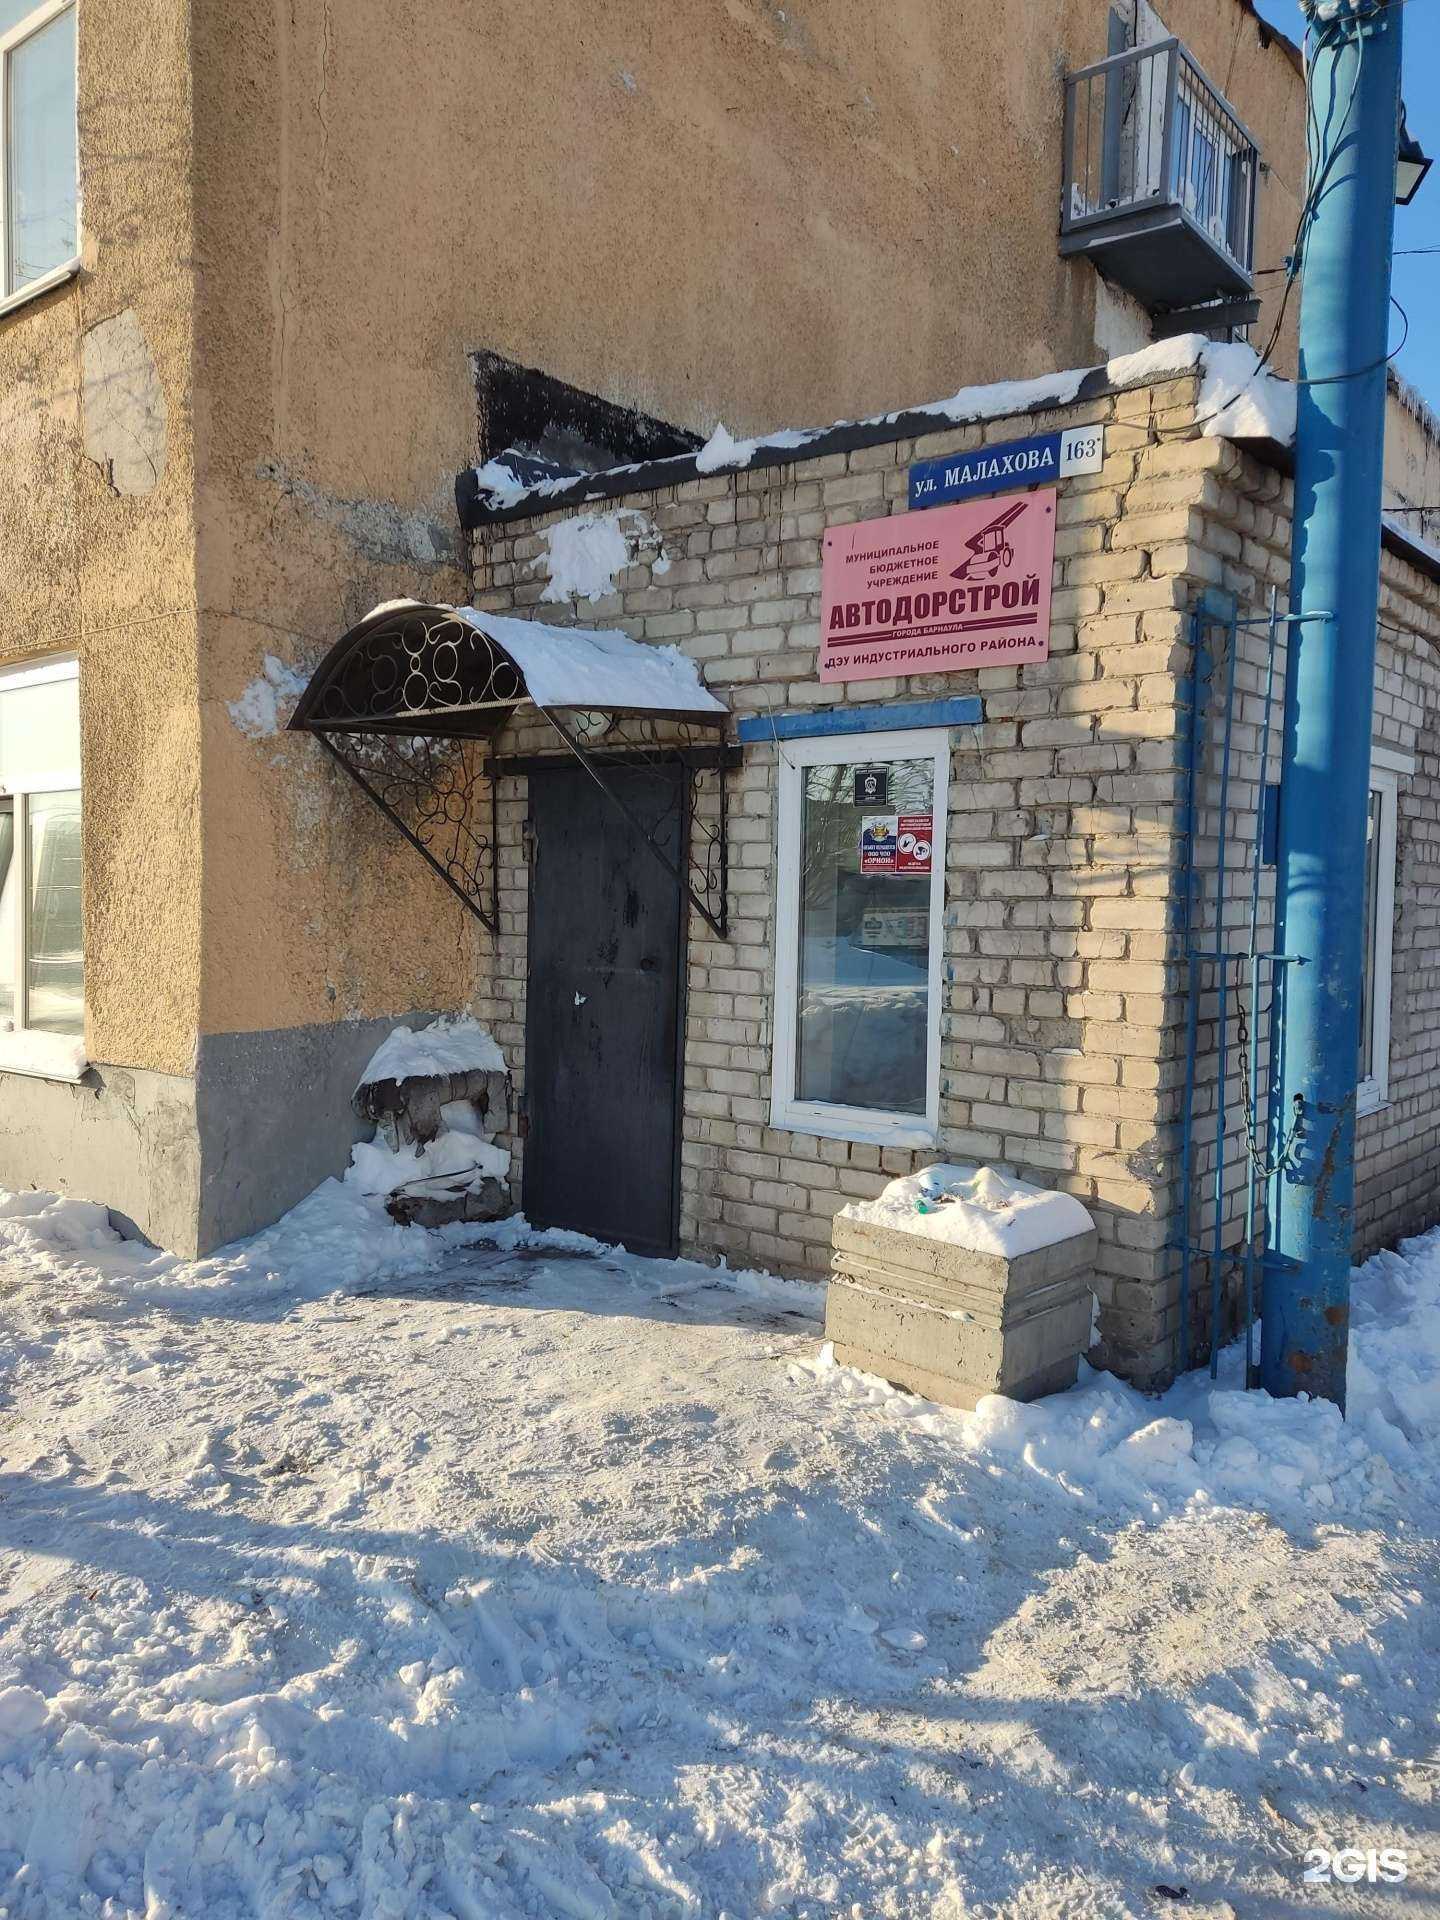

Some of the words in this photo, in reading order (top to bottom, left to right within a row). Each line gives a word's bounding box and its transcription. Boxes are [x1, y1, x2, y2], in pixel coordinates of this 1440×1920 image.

[915, 478, 937, 498] ул.
[944, 447, 1055, 488] МАЛАХОВА
[1066, 438, 1096, 462] 163
[845, 540, 940, 564] МУНИЦИПАЛЬНОЕ
[869, 555, 939, 575] БЮДЖЕТНОЕ
[866, 571, 938, 590] УЧРЕЖДЕНИЕ
[829, 573, 1040, 630] АВТОДОРСТРОЙ
[892, 628, 922, 639] ГОРОДА
[923, 623, 963, 635] БАРНАУЛА
[828, 656, 850, 669] ДЭУ
[853, 642, 976, 666] ИНДУСТРИАЛЬНОГО
[980, 636, 1036, 651] РАЙОНА
